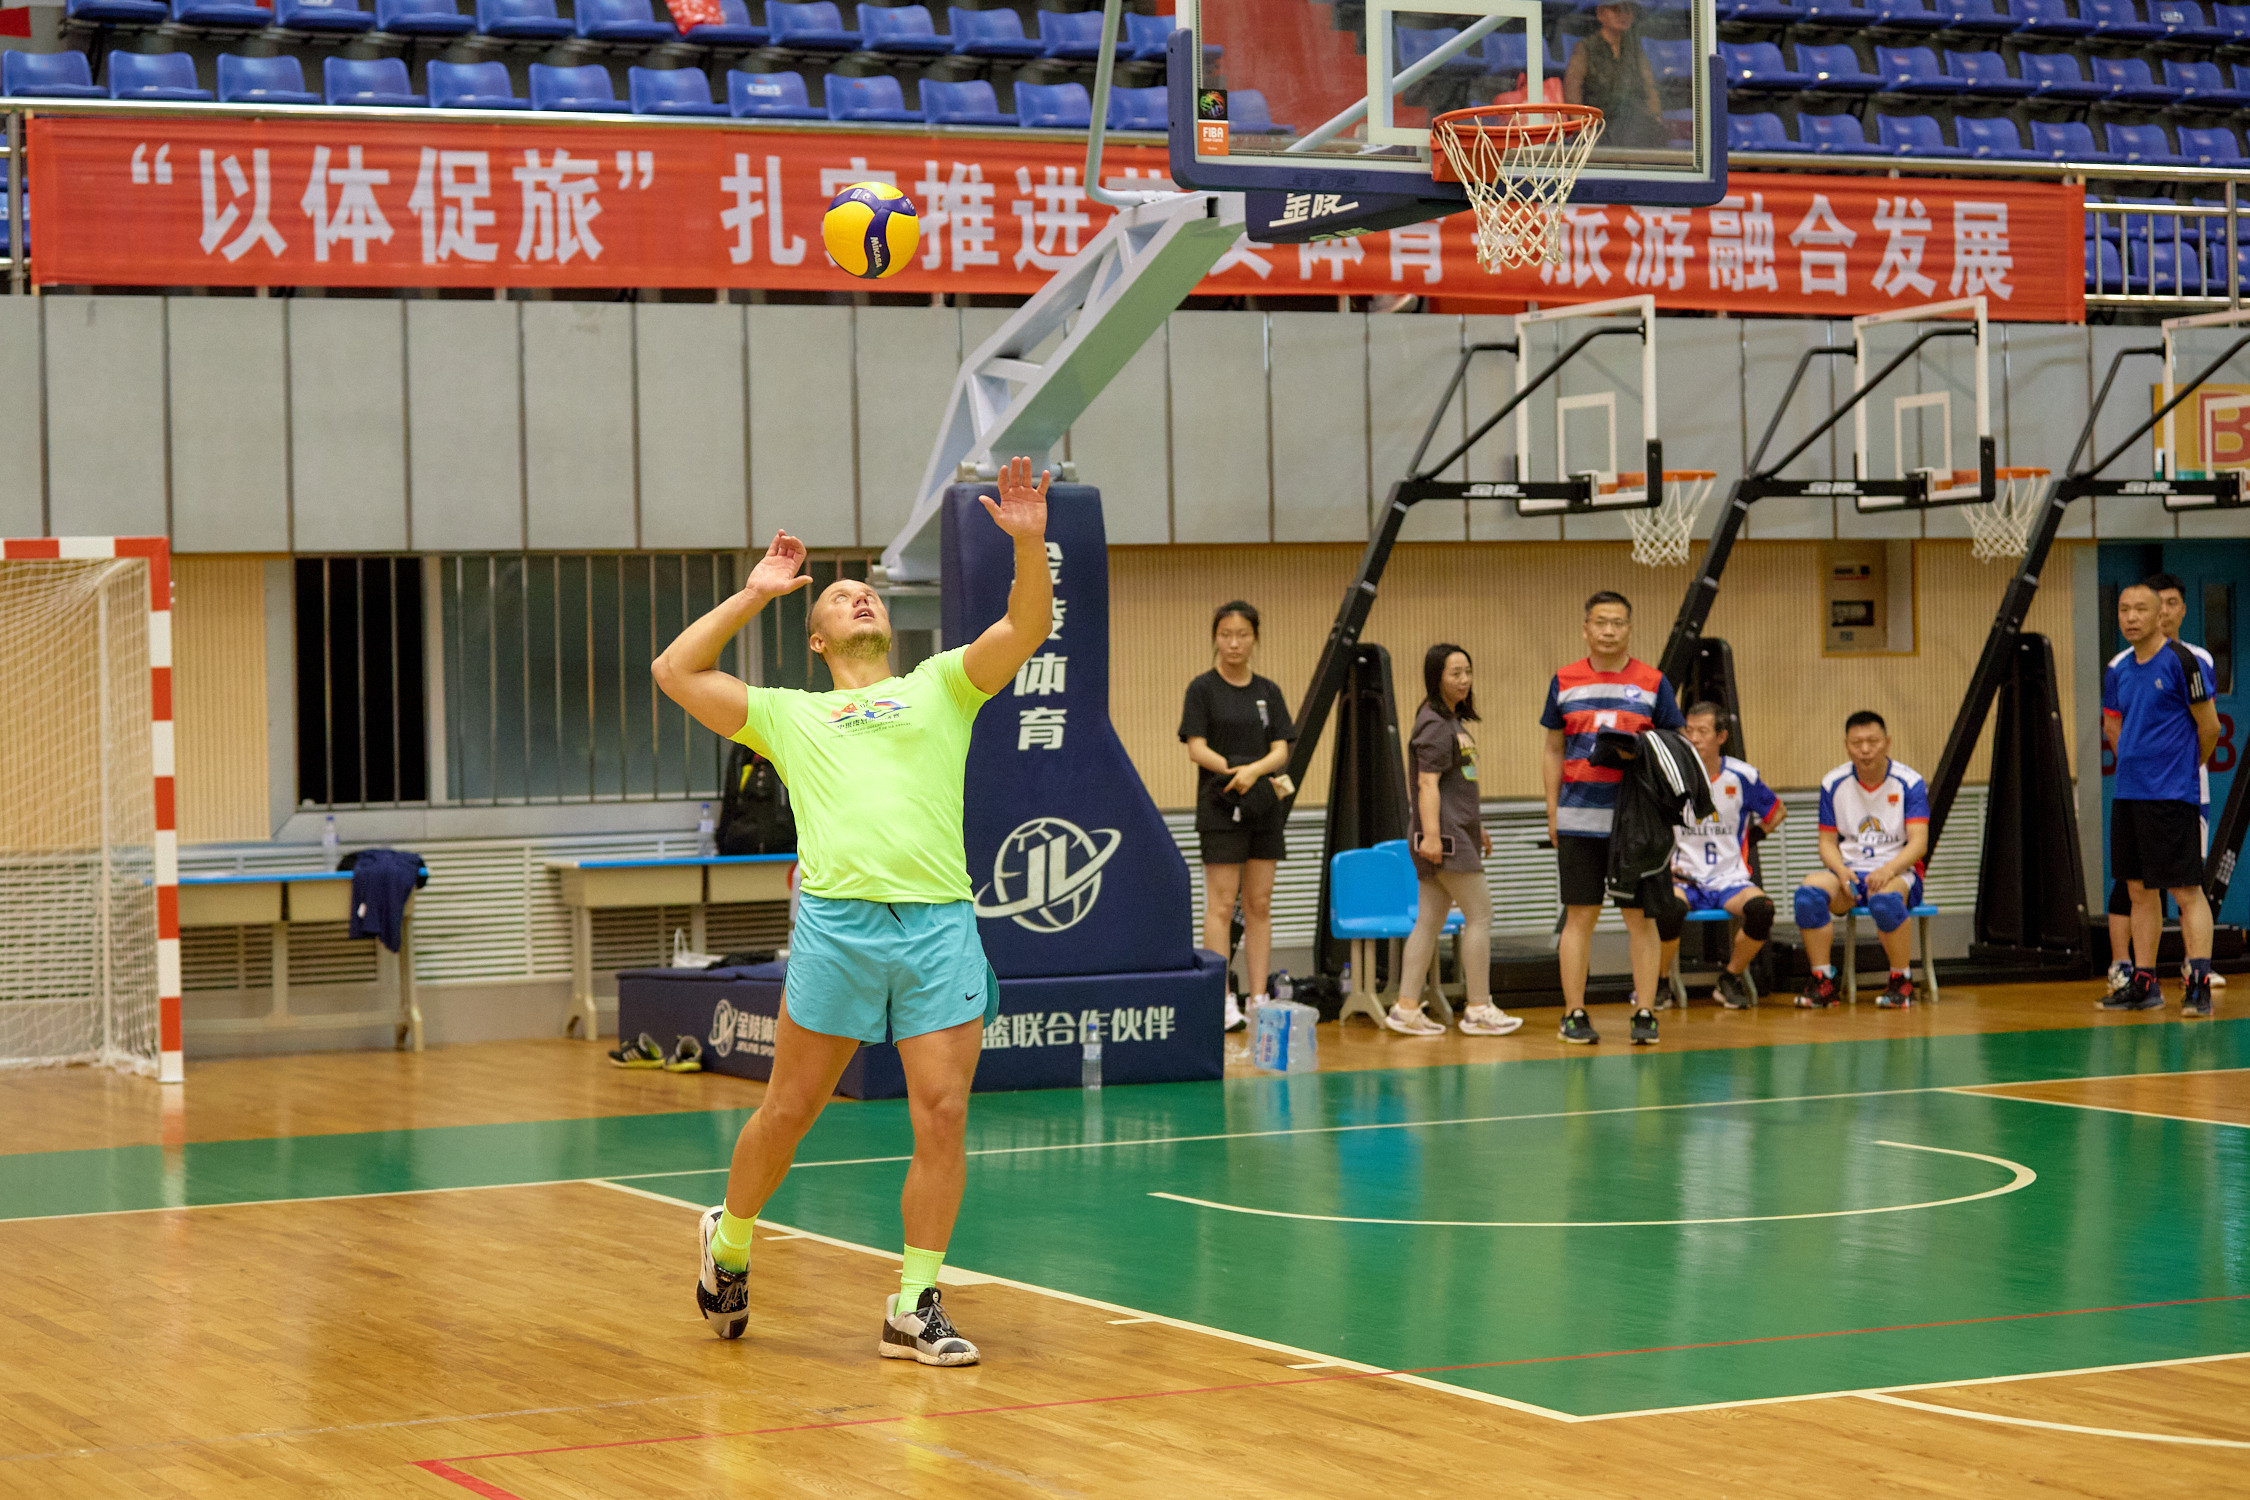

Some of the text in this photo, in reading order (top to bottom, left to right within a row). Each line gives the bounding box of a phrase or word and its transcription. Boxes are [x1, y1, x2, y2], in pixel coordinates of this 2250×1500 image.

[1202, 126, 1224, 138] FIBA
[131, 142, 655, 264] “以体促旅”
[1704, 841, 1717, 865] 6
